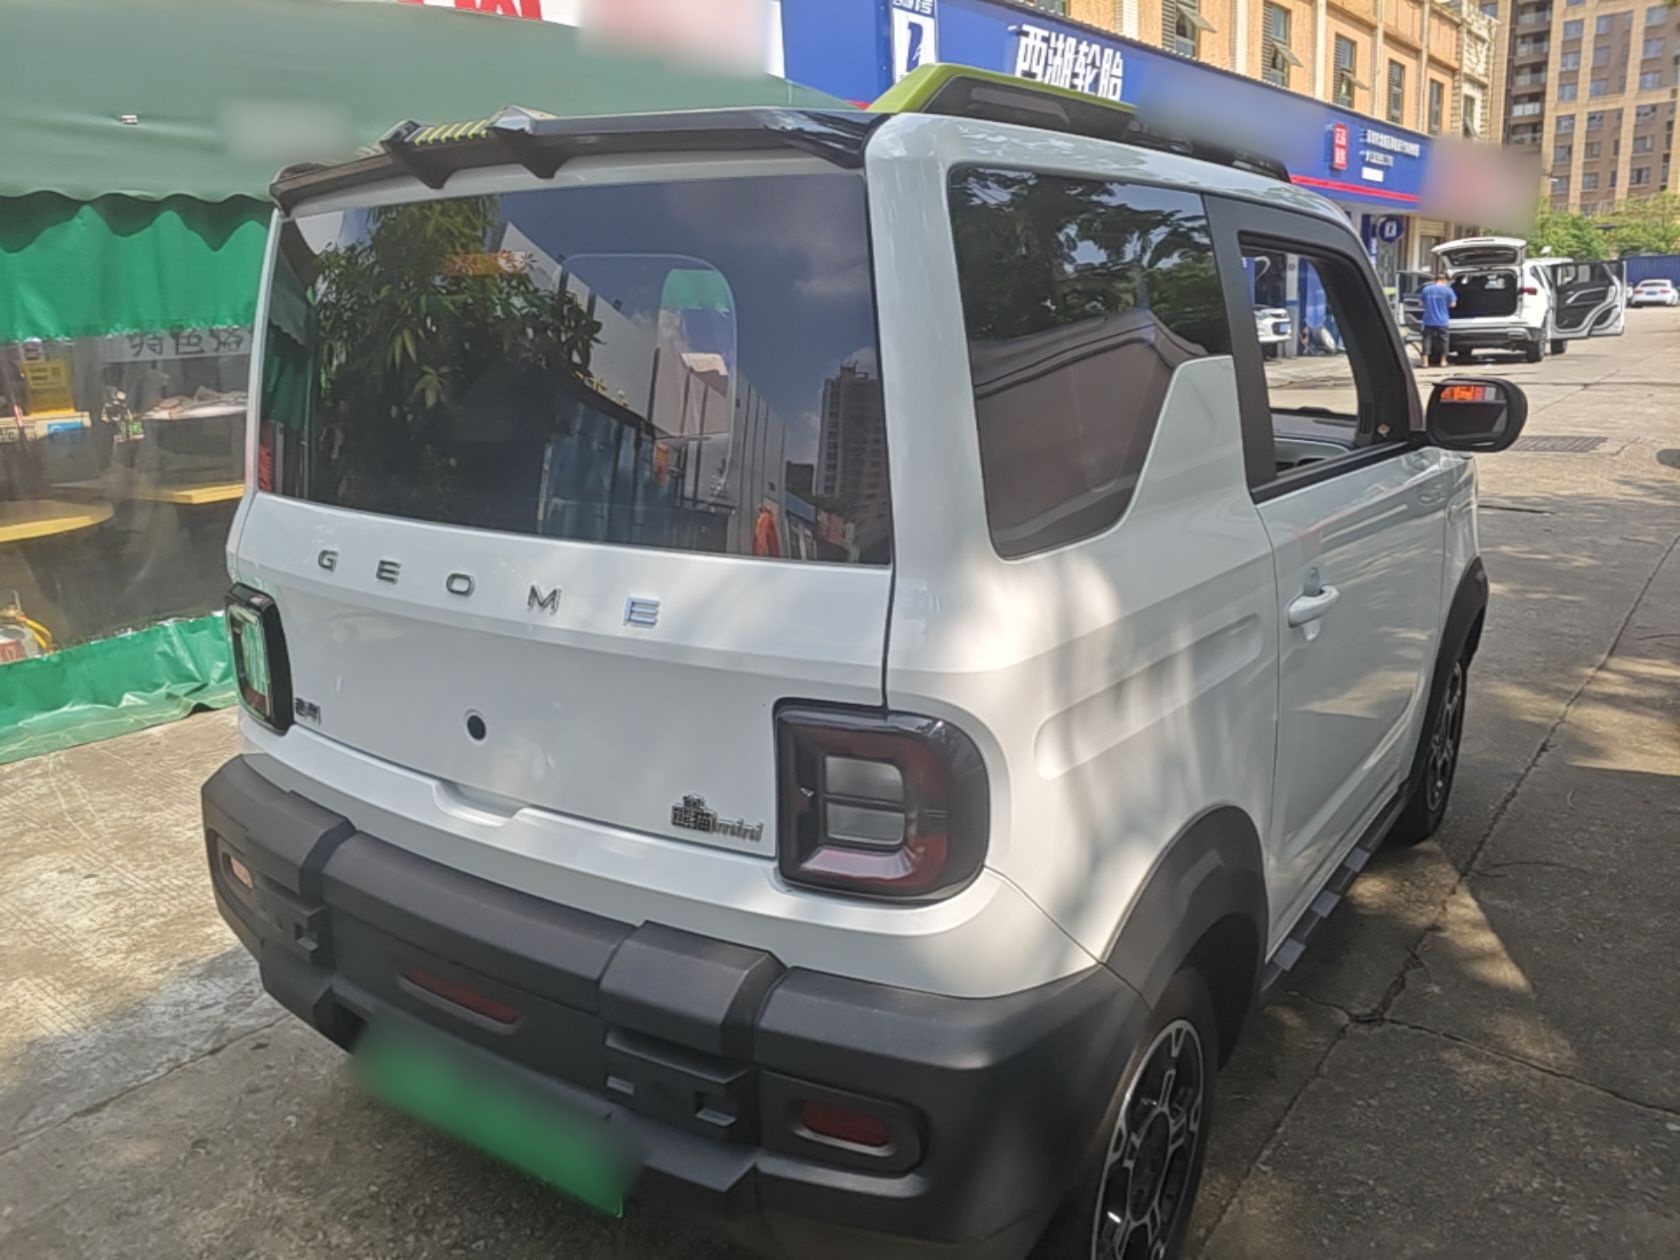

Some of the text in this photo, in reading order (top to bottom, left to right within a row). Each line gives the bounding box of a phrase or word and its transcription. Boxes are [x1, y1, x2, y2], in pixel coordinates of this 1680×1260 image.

[1014, 23, 1124, 102] 西湖轮胎
[317, 548, 661, 628] GEOME
